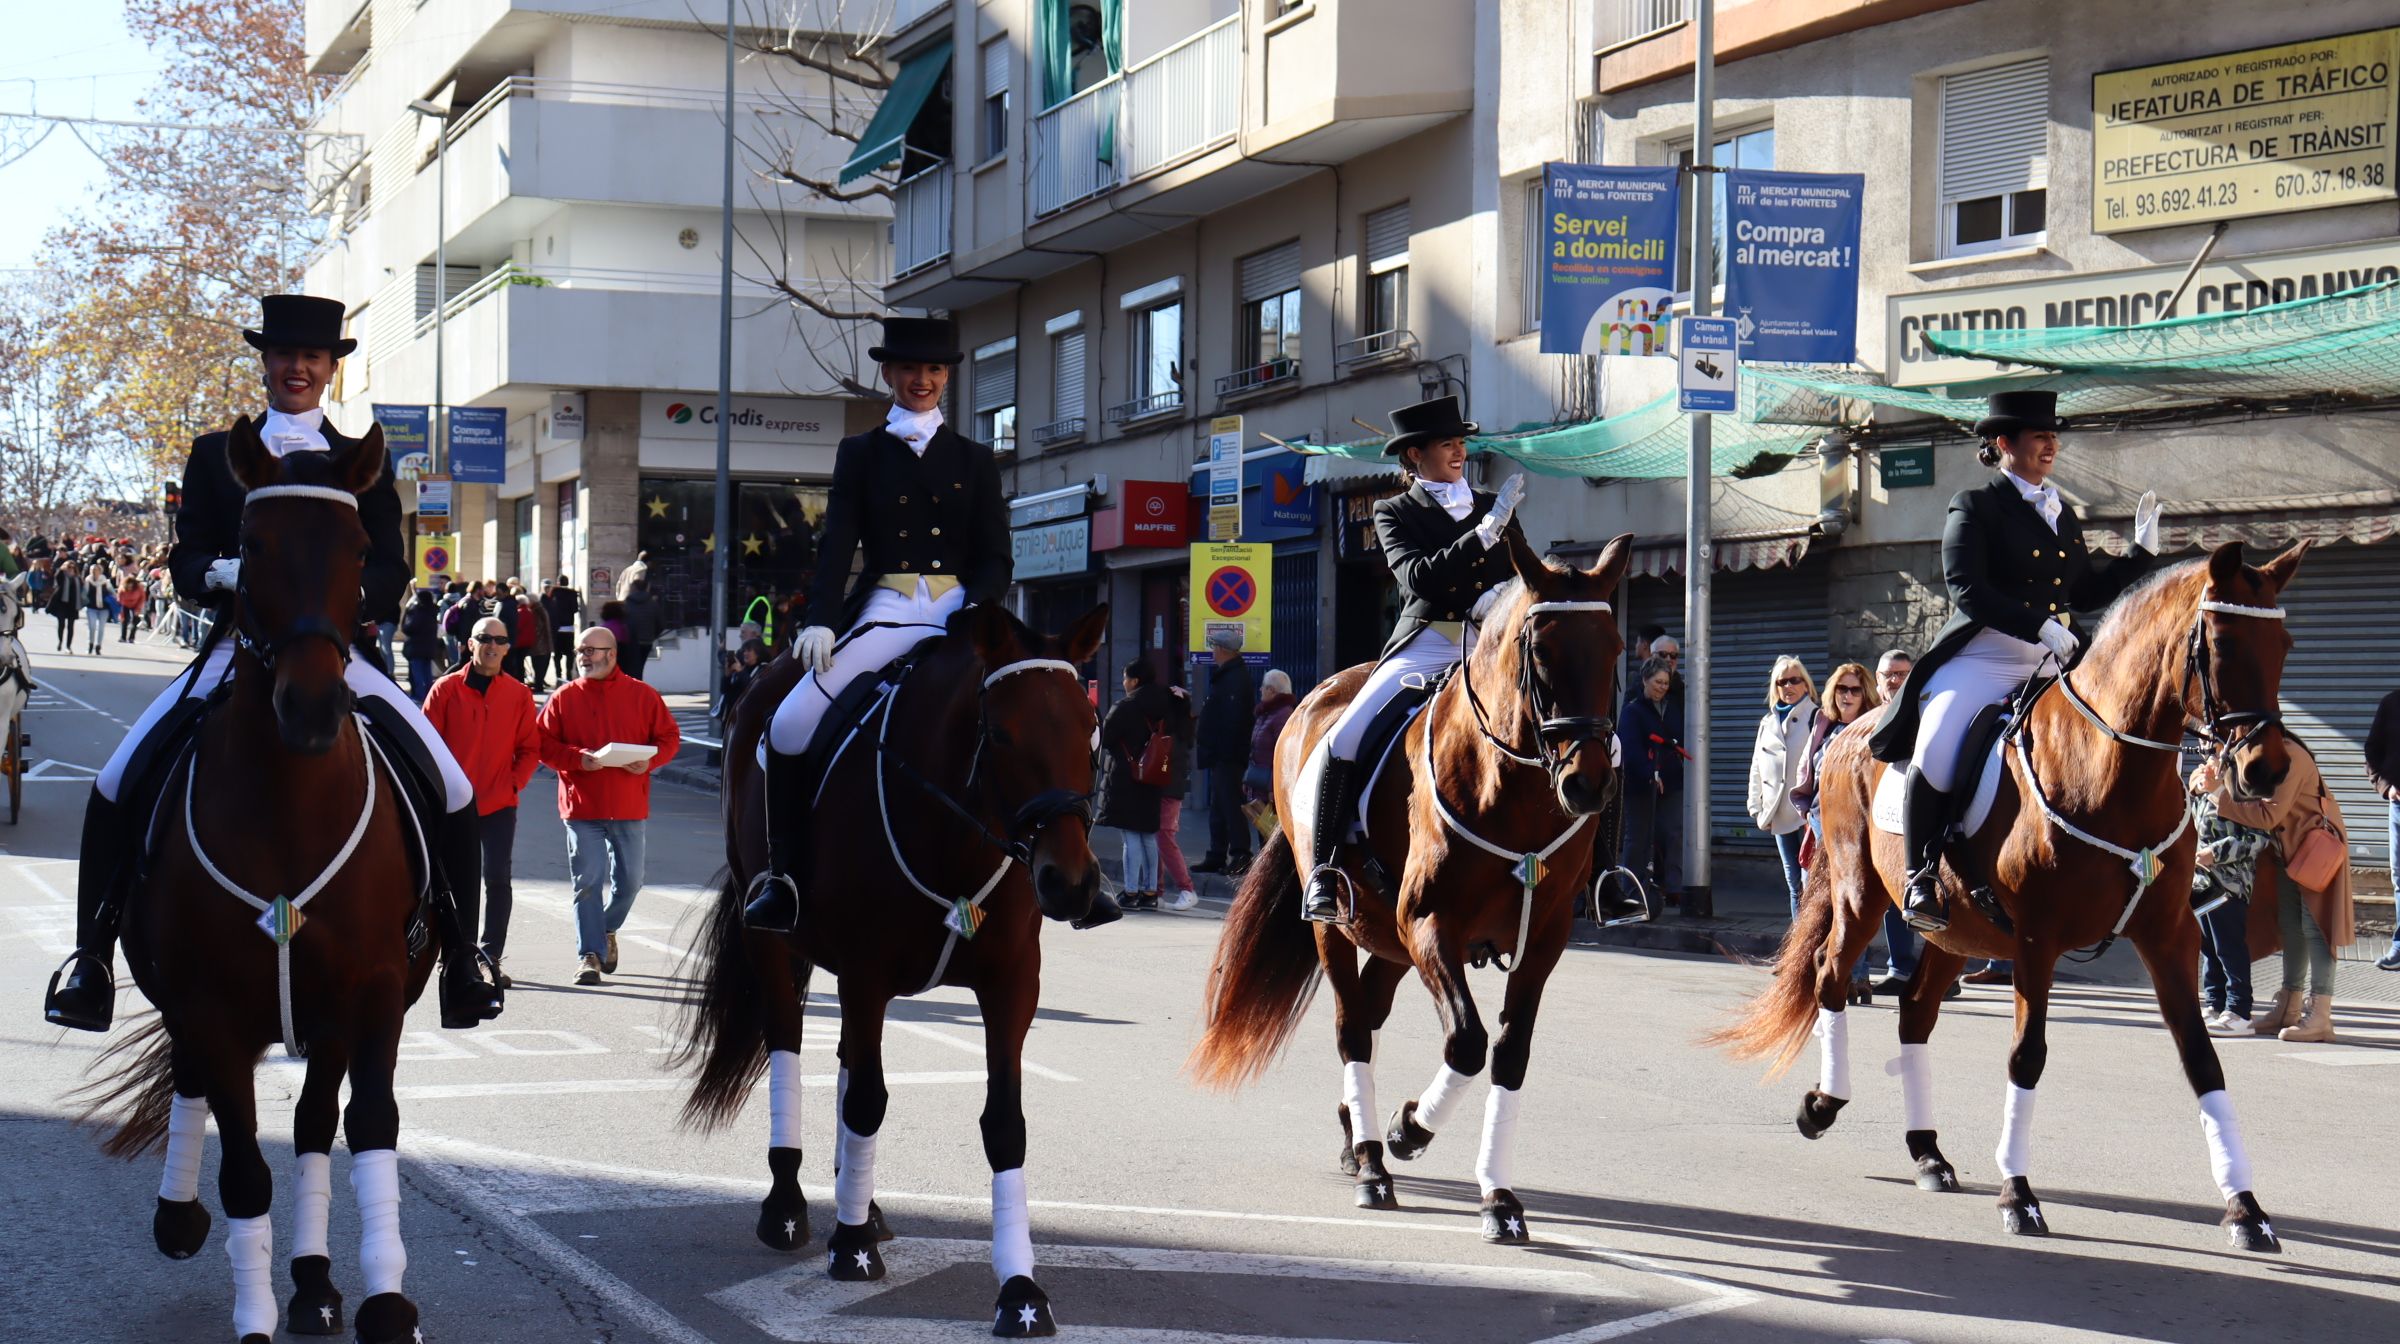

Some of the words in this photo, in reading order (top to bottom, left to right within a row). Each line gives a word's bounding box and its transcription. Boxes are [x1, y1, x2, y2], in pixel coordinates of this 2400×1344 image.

[2151, 68, 2219, 87] AUTORIZADO
[2225, 65, 2232, 76] Y
[2236, 53, 2306, 74] REGISTRADO
[2310, 50, 2338, 62] POR:
[2105, 88, 2222, 123] JEFATURA
[2233, 80, 2265, 105] DE
[2276, 62, 2389, 97] TRÁFICO
[2159, 124, 2224, 143] AUTORITZAT
[2228, 122, 2232, 133] I
[2235, 114, 2294, 132] REGISTRAT
[2300, 110, 2325, 123] PER:
[2104, 142, 2239, 180] PREFECTURA
[2250, 137, 2279, 160] DE
[2289, 122, 2387, 154] TRÀNSIT
[1577, 179, 1615, 190] MERCAT
[1617, 181, 1667, 192] MUNICIPAL
[2105, 196, 2129, 220] Tel.
[2136, 181, 2238, 216] 93.692.41.23
[2275, 162, 2385, 199] 670.37.18.38
[1576, 191, 1588, 199] de
[1591, 192, 1604, 200] les
[1607, 192, 1653, 201] FONTETES
[1760, 186, 1798, 197] MERCAT
[1801, 188, 1851, 198] MUNICIPAL
[1760, 197, 1772, 206] de
[1774, 198, 1788, 206] les
[1791, 198, 1837, 208] FONTETES
[1553, 213, 1628, 236] Servei
[1736, 220, 1825, 247] Compra
[1553, 241, 1566, 257] a
[1570, 237, 1665, 260] domicili
[1736, 244, 1754, 264] al
[1552, 263, 1594, 273] Recollida
[1597, 265, 1609, 273] en
[1611, 265, 1663, 276] consignes
[1552, 273, 1578, 284] Venda
[1580, 275, 1610, 285] online
[1694, 321, 1725, 332] Càmera
[1760, 319, 1799, 327] Ajuntament
[1759, 327, 1800, 336] Cerdanyola
[1690, 334, 1701, 343] de
[1702, 335, 1728, 345] trànsit
[452, 425, 492, 437] Compra
[765, 419, 820, 433] express
[452, 435, 462, 444] al
[1273, 510, 1312, 522] Naturgy
[1134, 523, 1177, 532] MAPFRE
